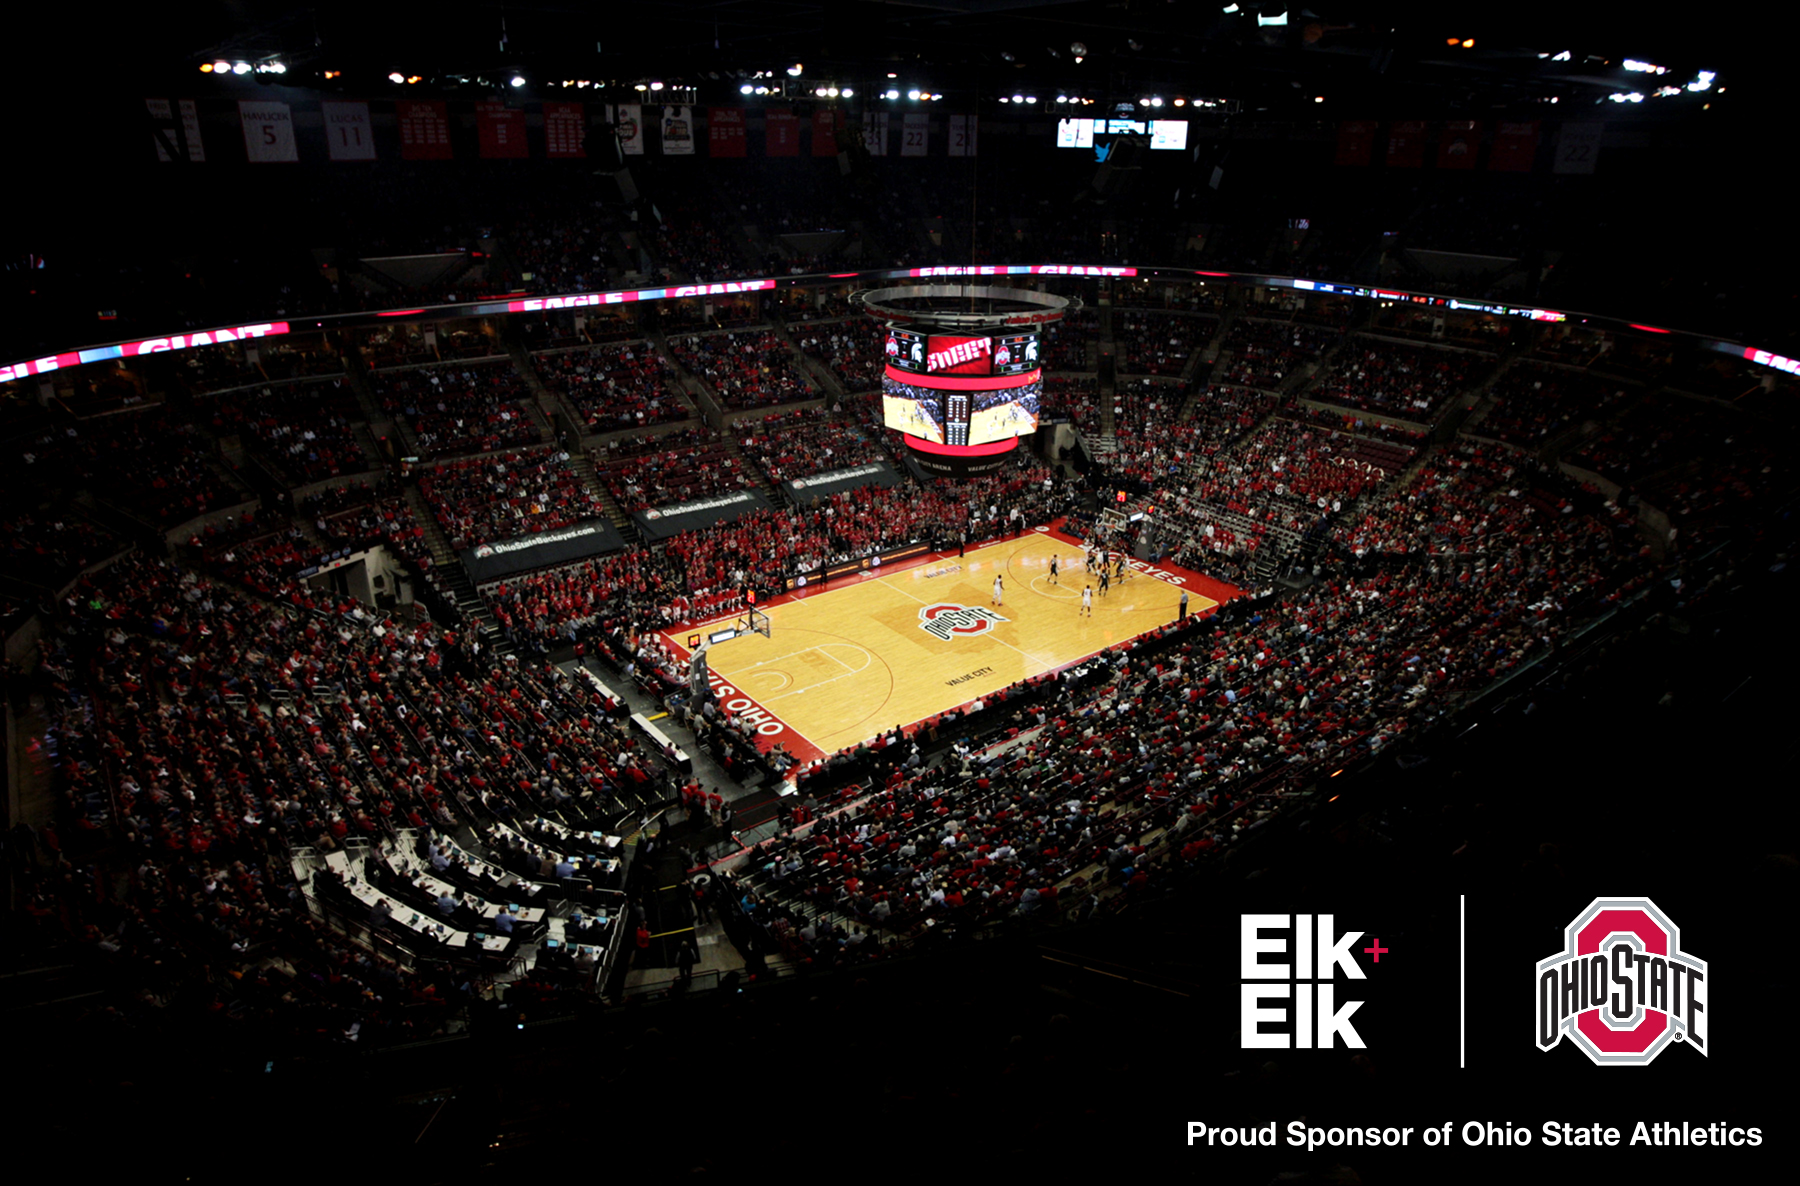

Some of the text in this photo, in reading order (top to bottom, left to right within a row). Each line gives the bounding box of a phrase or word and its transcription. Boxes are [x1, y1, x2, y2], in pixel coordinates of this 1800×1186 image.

[330, 113, 364, 123] LUCAS
[263, 125, 277, 145] 5
[339, 127, 362, 147] 11
[906, 132, 923, 146] 22
[1564, 144, 1591, 162] 22
[138, 324, 272, 355] GIANT
[967, 464, 987, 472] VALUE
[662, 495, 748, 517] OhioStateBuckeyes.com
[495, 526, 595, 554] OhioStateBuckeyes.com
[924, 608, 1006, 640] OHIO STATE
[945, 673, 975, 687] VALUE
[972, 666, 994, 677] CITY
